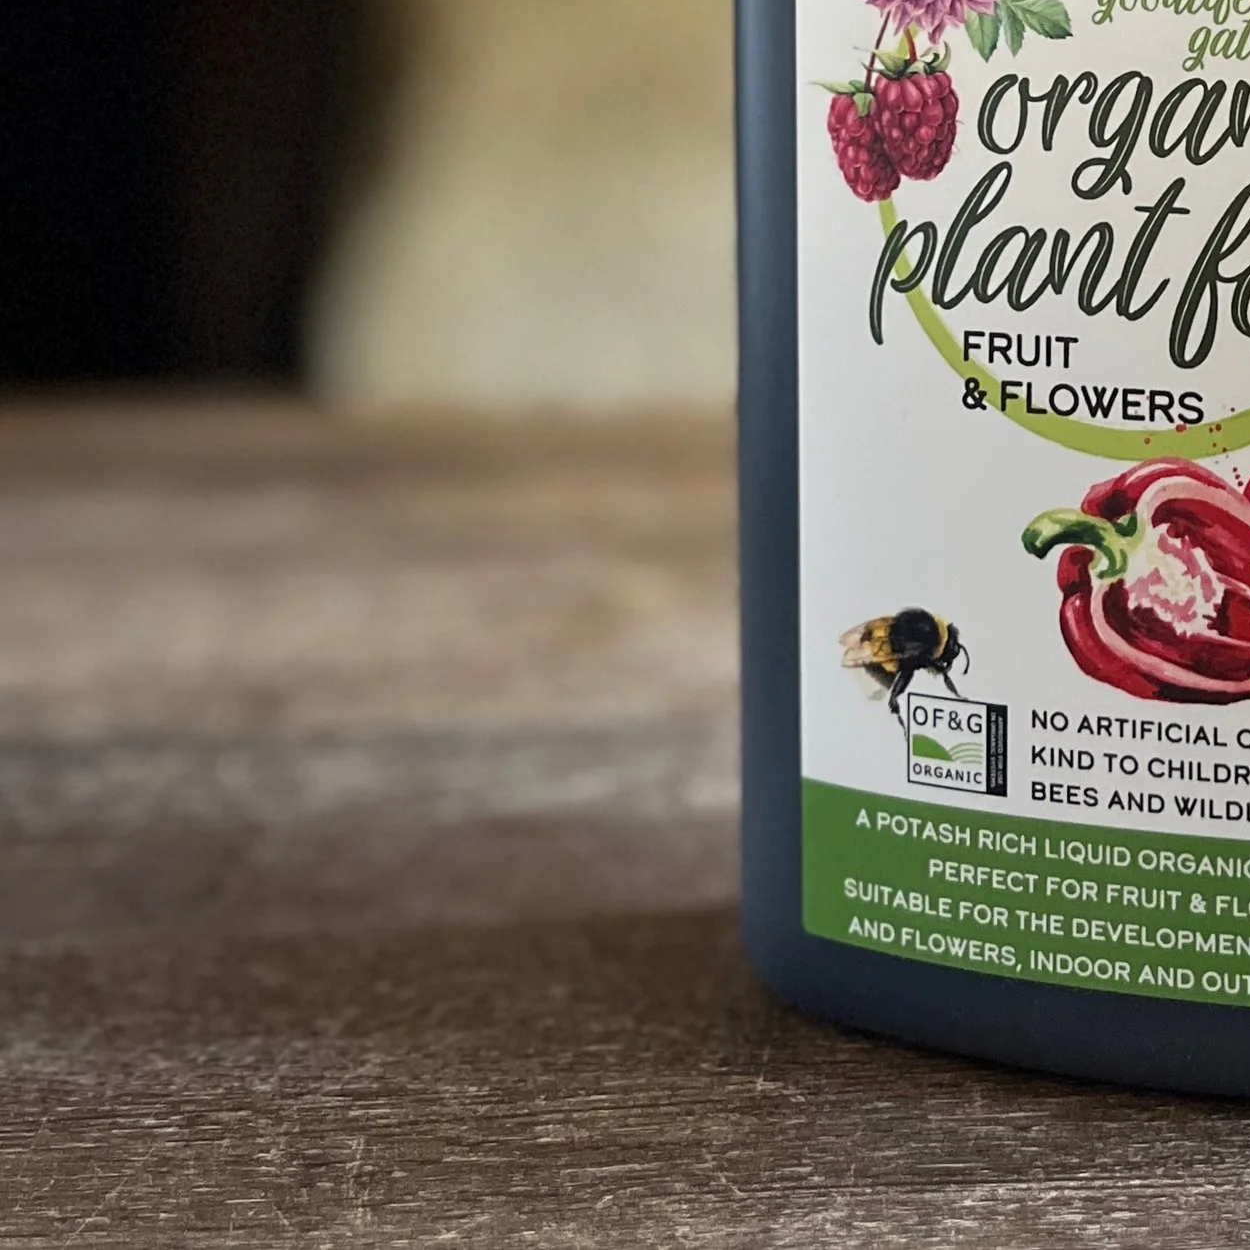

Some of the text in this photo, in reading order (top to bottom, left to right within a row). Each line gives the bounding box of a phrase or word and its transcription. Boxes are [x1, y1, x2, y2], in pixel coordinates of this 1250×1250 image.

[869, 161, 1190, 345] plant
[963, 330, 1078, 368] FRUIT
[962, 377, 1204, 425] & FLOWERS
[913, 705, 983, 734] OF&G
[1032, 709, 1069, 732] NO
[1077, 714, 1228, 747] ARTIFICIAL
[912, 762, 983, 784] ORGANIC
[1031, 745, 1095, 770] KIND
[1103, 753, 1139, 775] TO
[1031, 781, 1099, 807] BEES
[1108, 790, 1165, 814] AND
[856, 808, 871, 828] A
[877, 811, 971, 847] POTASH
[978, 829, 1037, 856] RICH
[1045, 838, 1131, 867] LIQUID
[844, 878, 952, 918] SUITABLE
[959, 902, 1009, 927] FOR
[1016, 910, 1064, 936] THE
[929, 858, 1038, 893] PERFECT
[1046, 876, 1098, 902] FOR
[1106, 884, 1182, 911] FRUIT
[1189, 893, 1206, 914] &
[849, 916, 895, 943] AND
[901, 927, 1022, 973] FLOWERS,
[1030, 949, 1131, 983] INDOOR
[1138, 964, 1194, 989] AND
